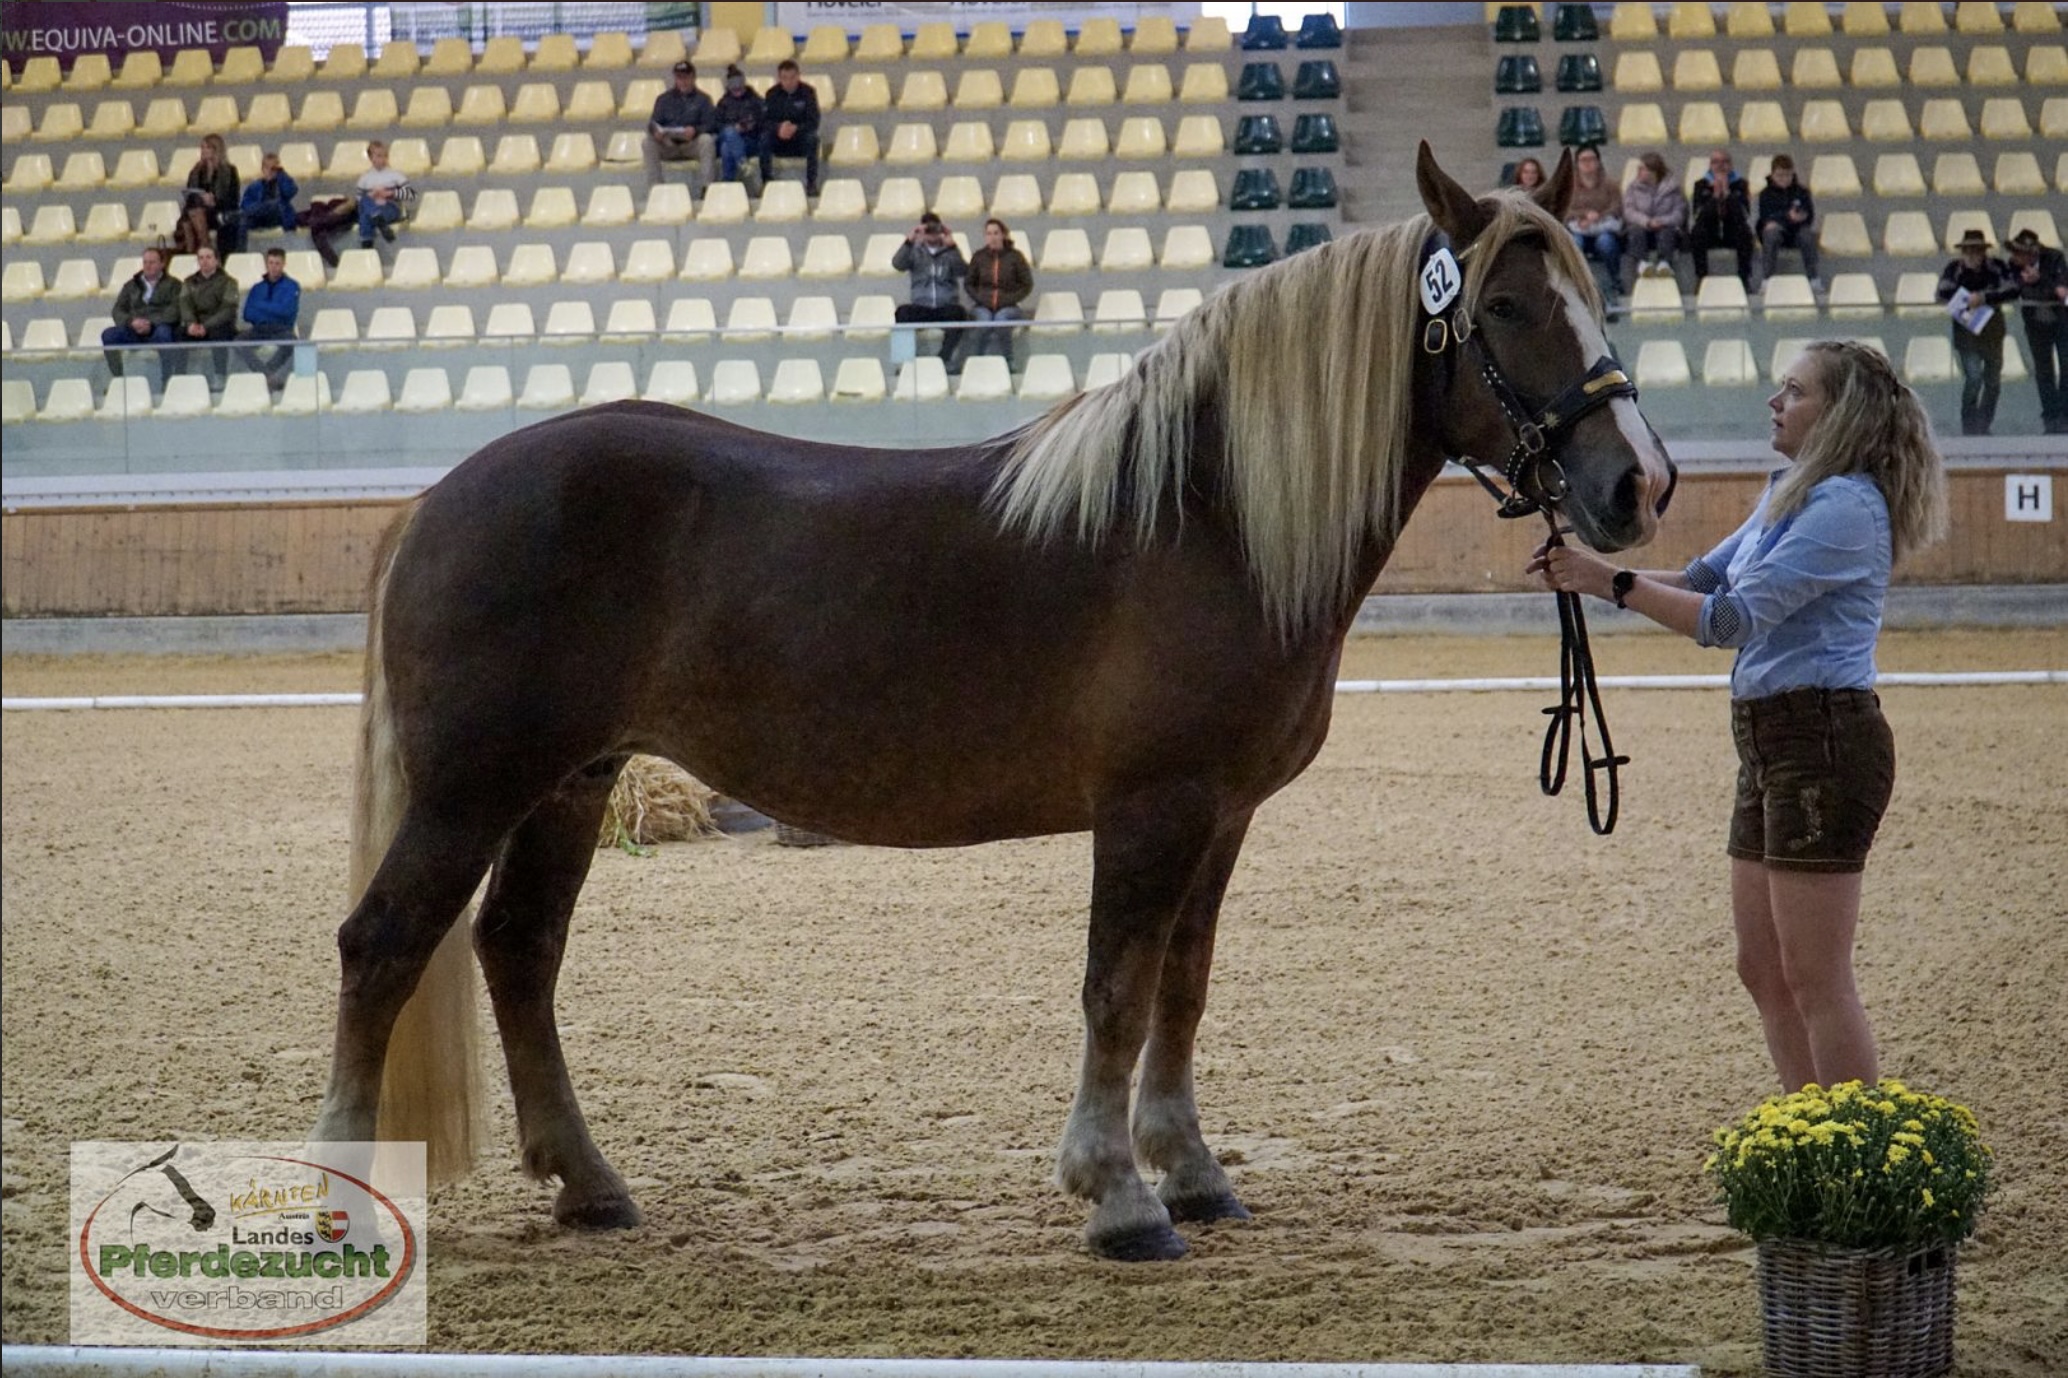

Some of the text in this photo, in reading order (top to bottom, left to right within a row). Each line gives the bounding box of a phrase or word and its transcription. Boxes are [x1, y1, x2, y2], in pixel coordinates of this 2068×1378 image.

[2, 19, 280, 52] W.EQUIVA-ONLINE.COM
[1425, 258, 1454, 303] 52
[2018, 484, 2039, 510] H
